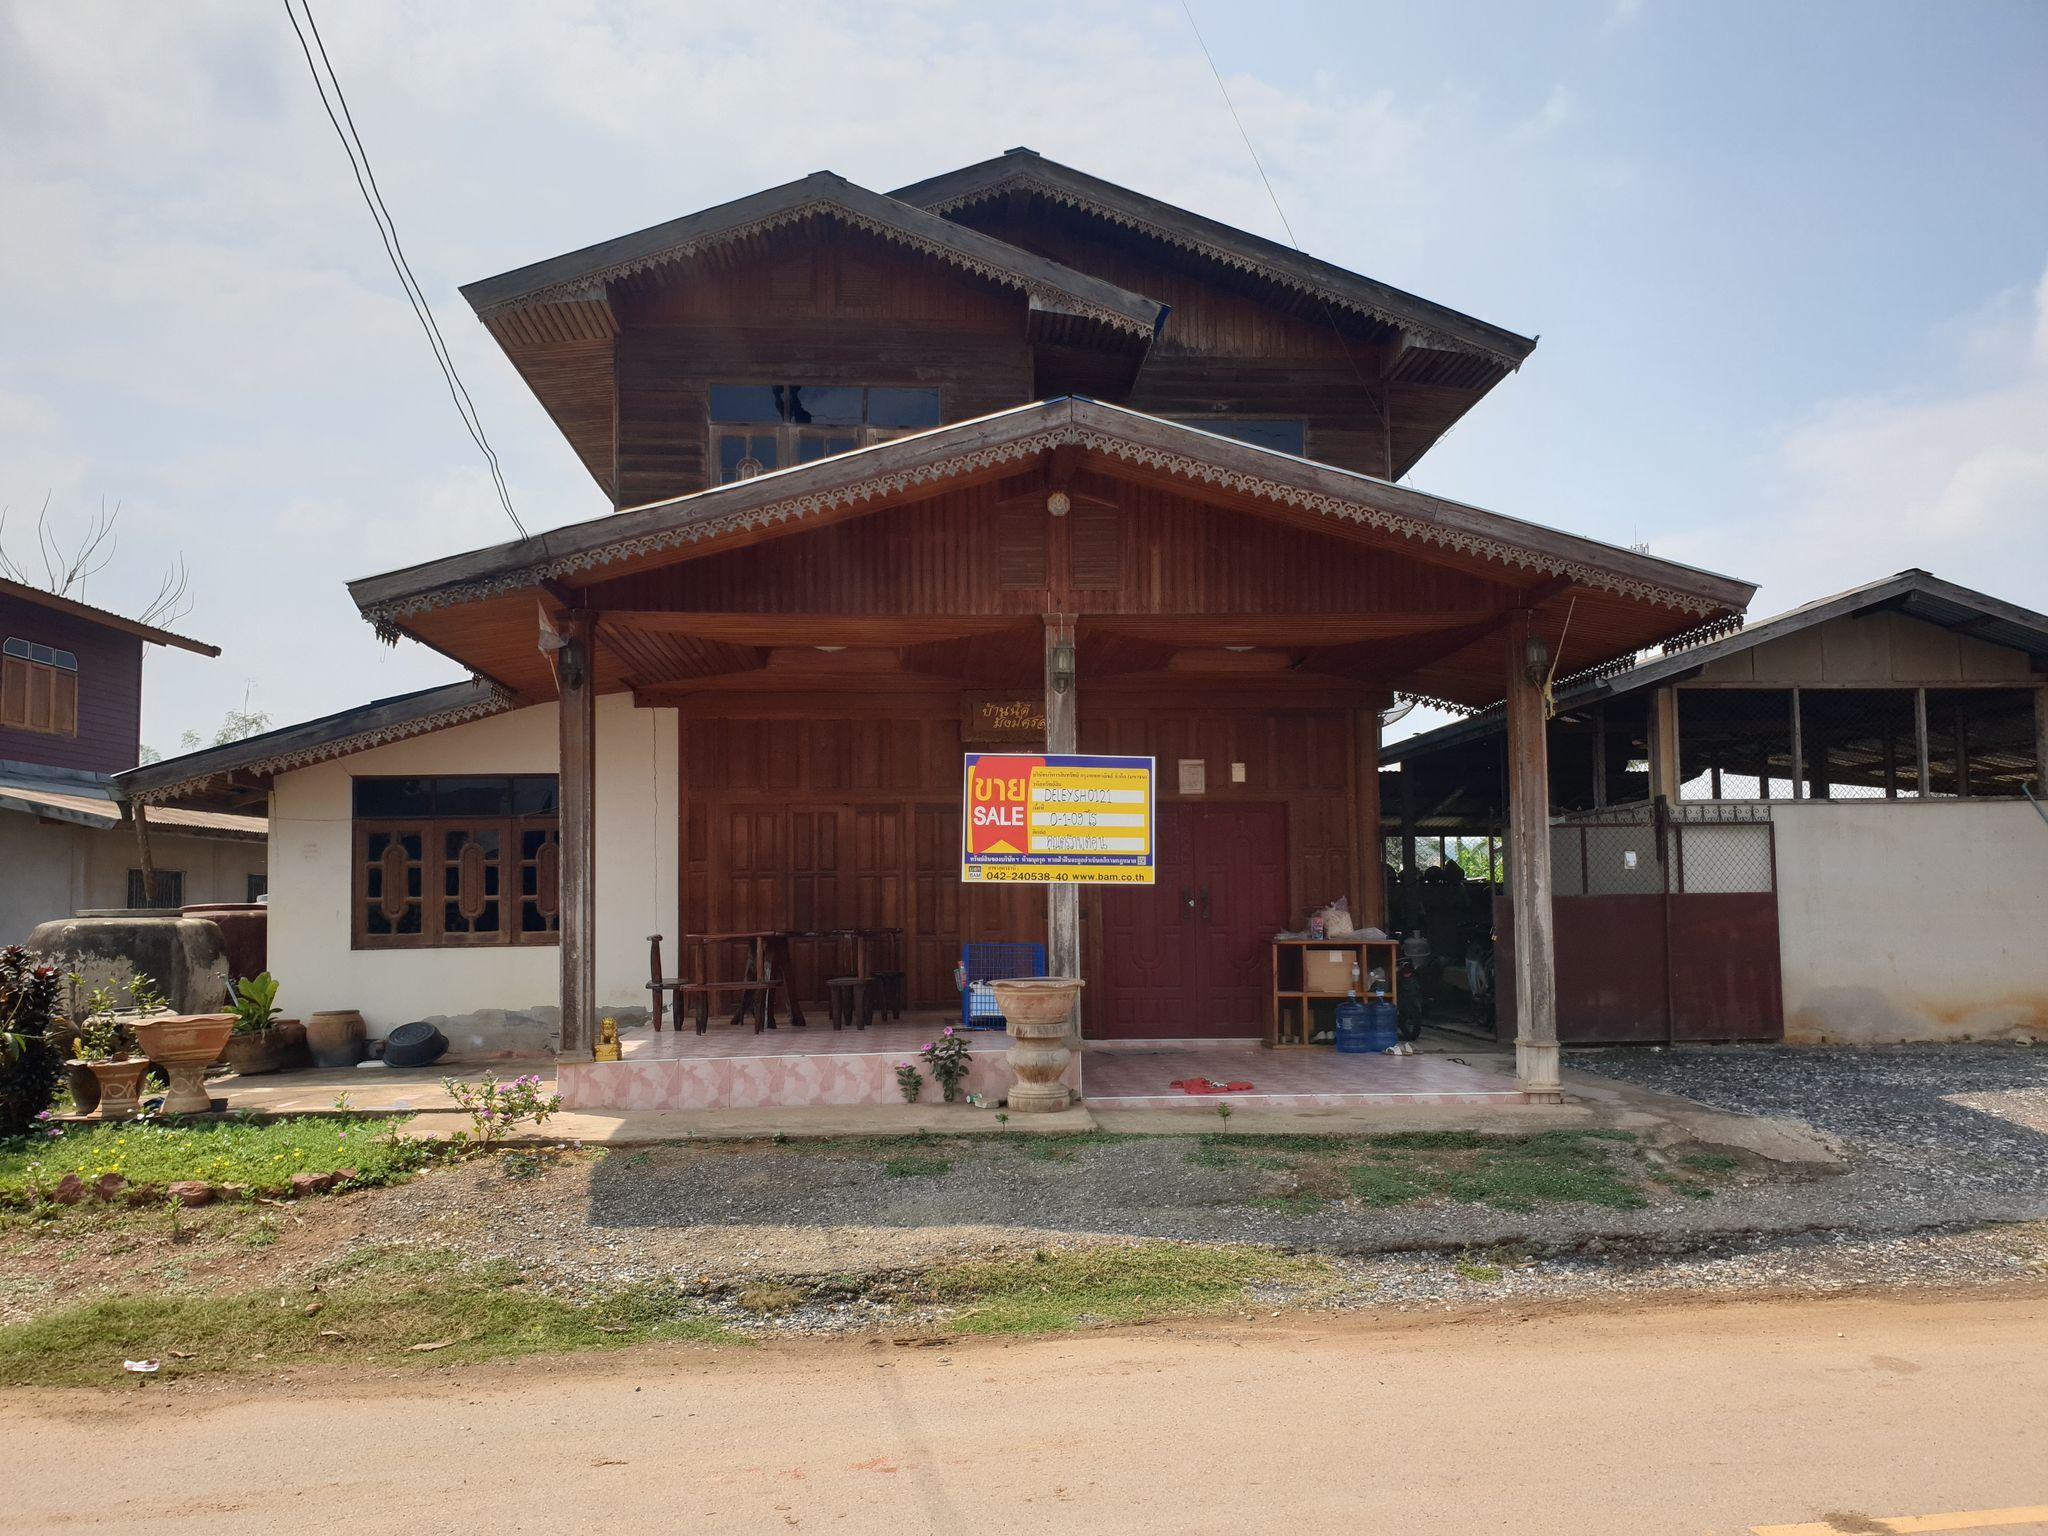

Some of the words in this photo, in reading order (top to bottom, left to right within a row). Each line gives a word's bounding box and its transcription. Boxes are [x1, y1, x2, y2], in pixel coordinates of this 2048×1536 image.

[975, 778, 1025, 801] ขาย
[973, 806, 1025, 826] SALE
[986, 871, 1069, 882] 042-240538-40
[1072, 873, 1145, 882] www.bam.co.th
